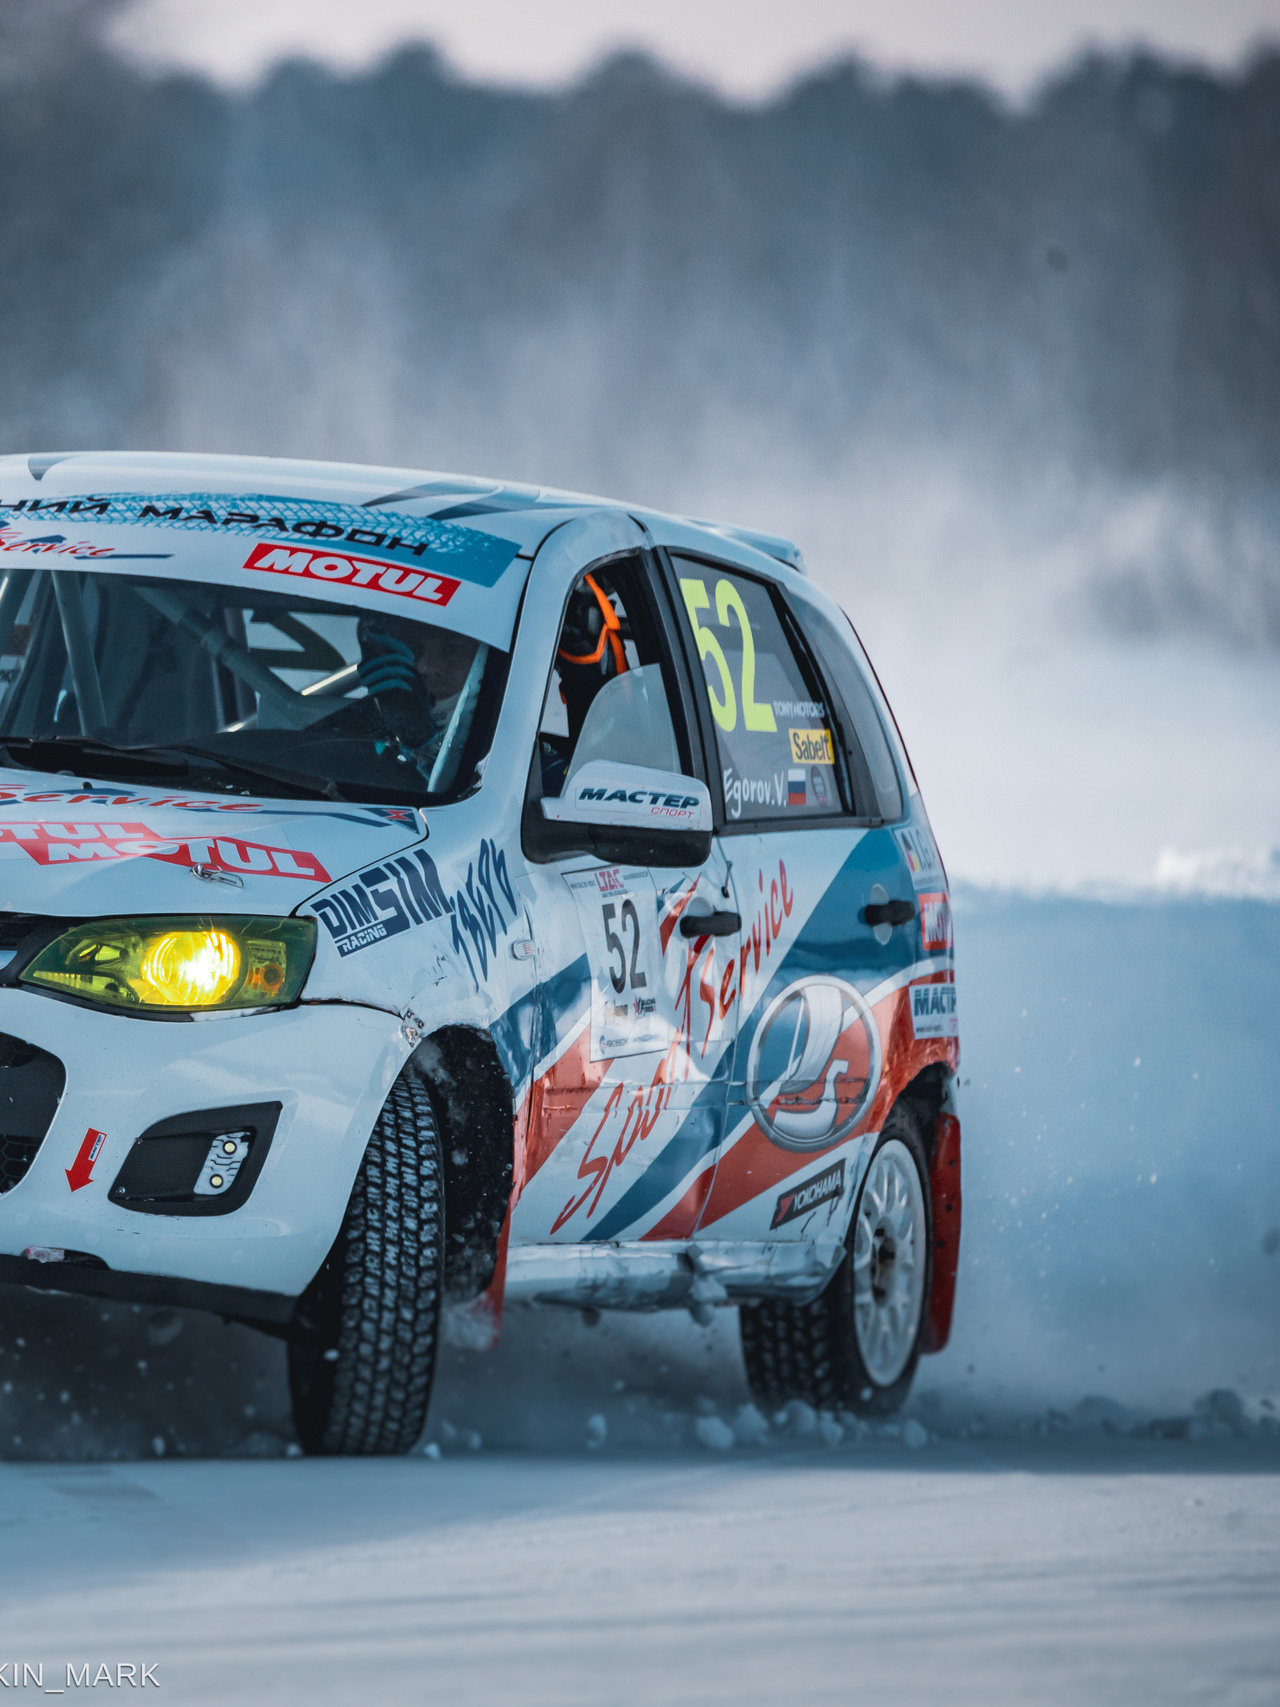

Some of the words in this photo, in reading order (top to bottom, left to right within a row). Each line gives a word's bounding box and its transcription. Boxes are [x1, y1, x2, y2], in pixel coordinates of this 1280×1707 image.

[137, 504, 430, 557] МАРАФОН
[253, 548, 447, 602] MOTUL
[680, 577, 778, 733] 52
[793, 732, 832, 761] Sabelt
[578, 788, 700, 809] МАСТЕР
[48, 836, 316, 876] MOTUL
[601, 899, 648, 994] 52
